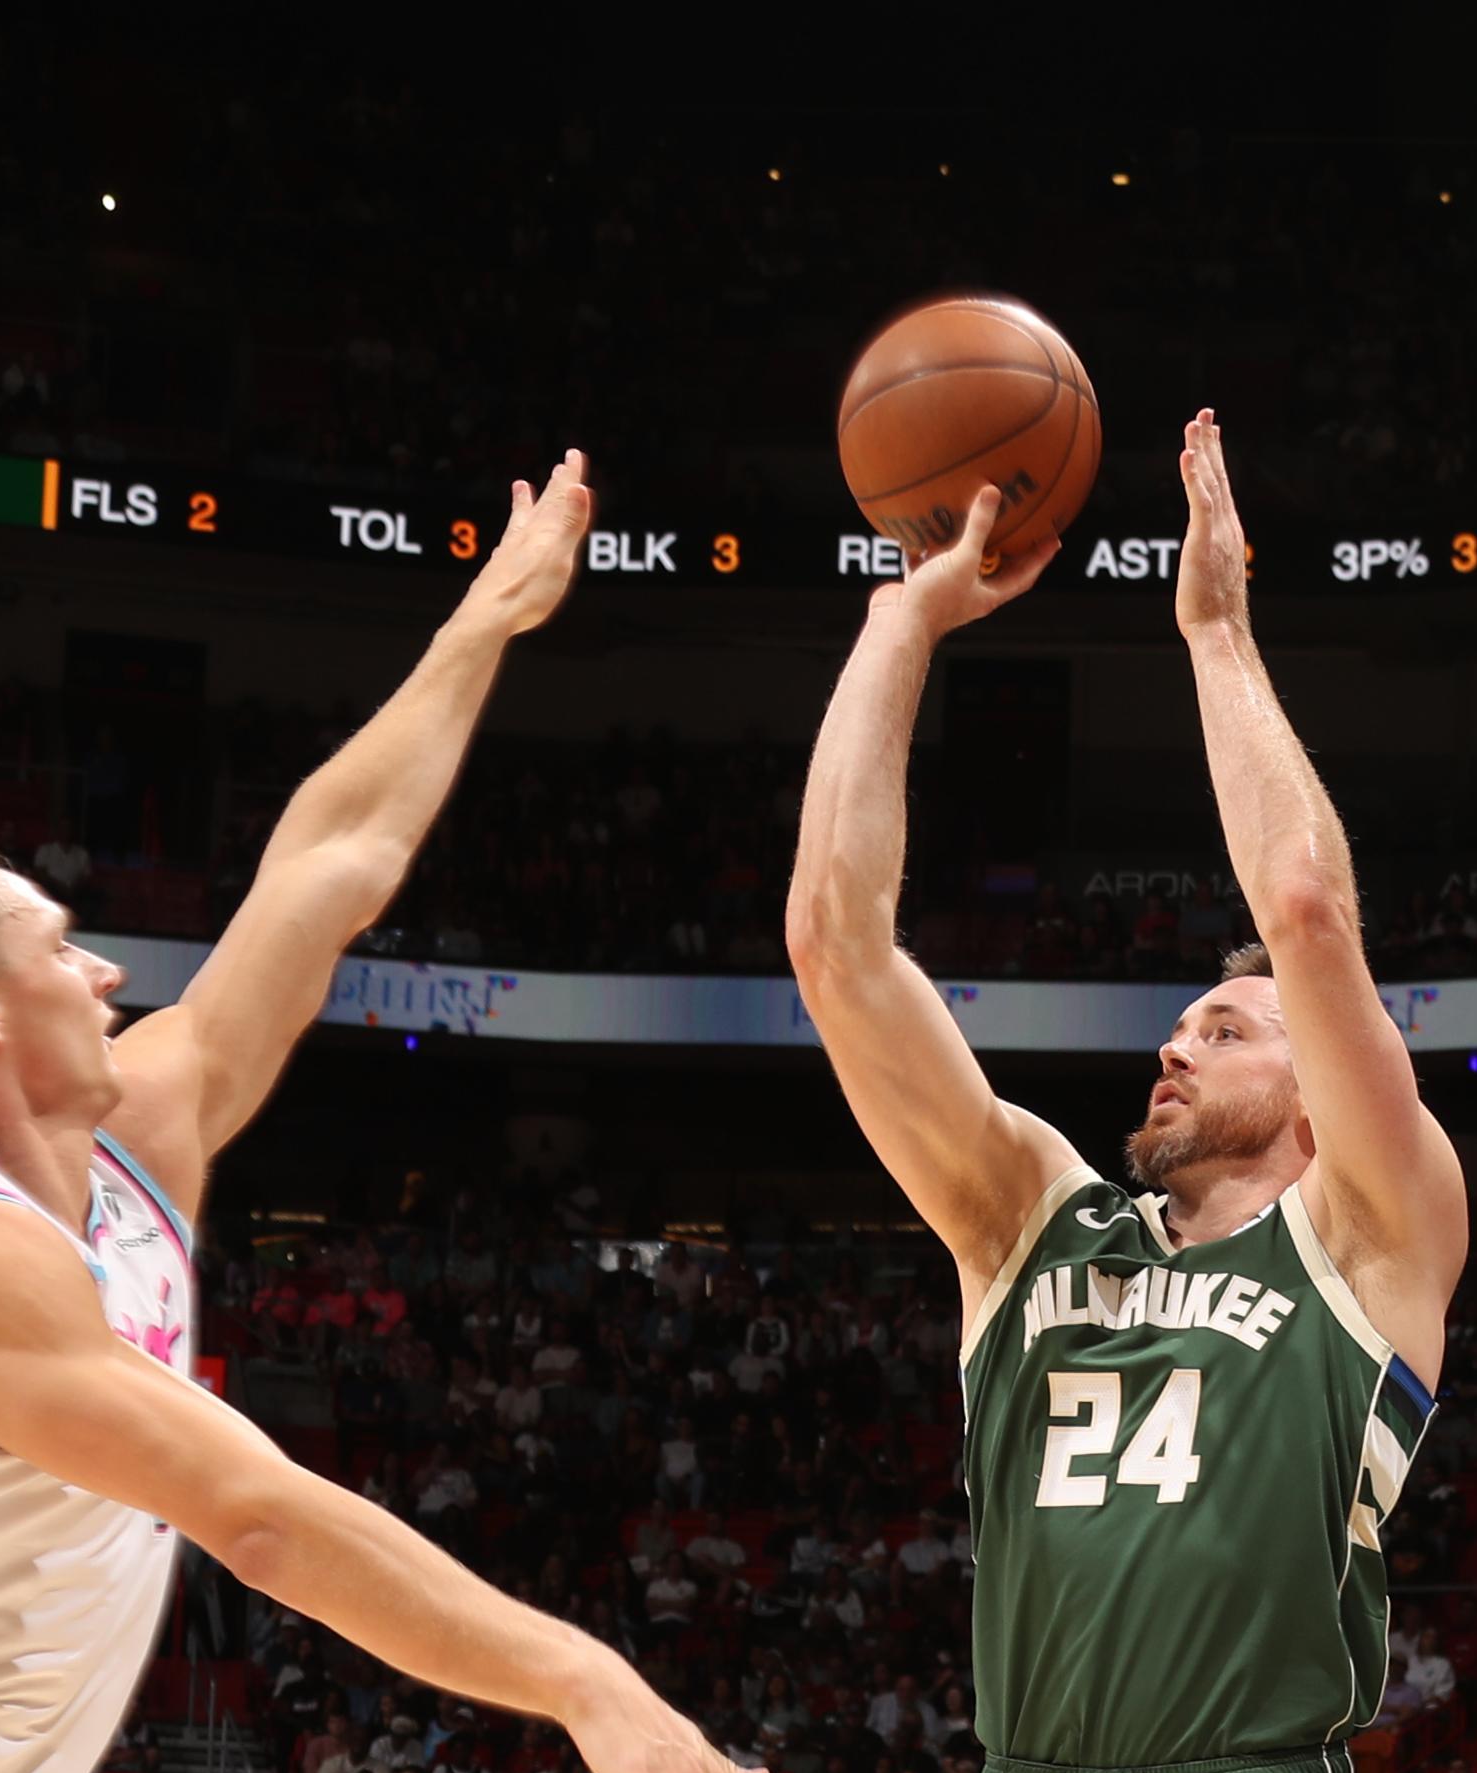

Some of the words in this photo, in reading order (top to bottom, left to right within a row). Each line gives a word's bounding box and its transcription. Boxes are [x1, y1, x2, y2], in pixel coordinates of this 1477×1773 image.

[71, 478, 158, 526] FLS
[188, 492, 218, 532] 2
[329, 505, 423, 555] TOL
[448, 518, 479, 561] 3
[589, 529, 678, 573] BLK
[712, 533, 740, 573] 3
[838, 534, 906, 577] RE
[1084, 537, 1181, 580] AST
[1331, 538, 1430, 581] 3P%
[1034, 1367, 1202, 1508] 24
